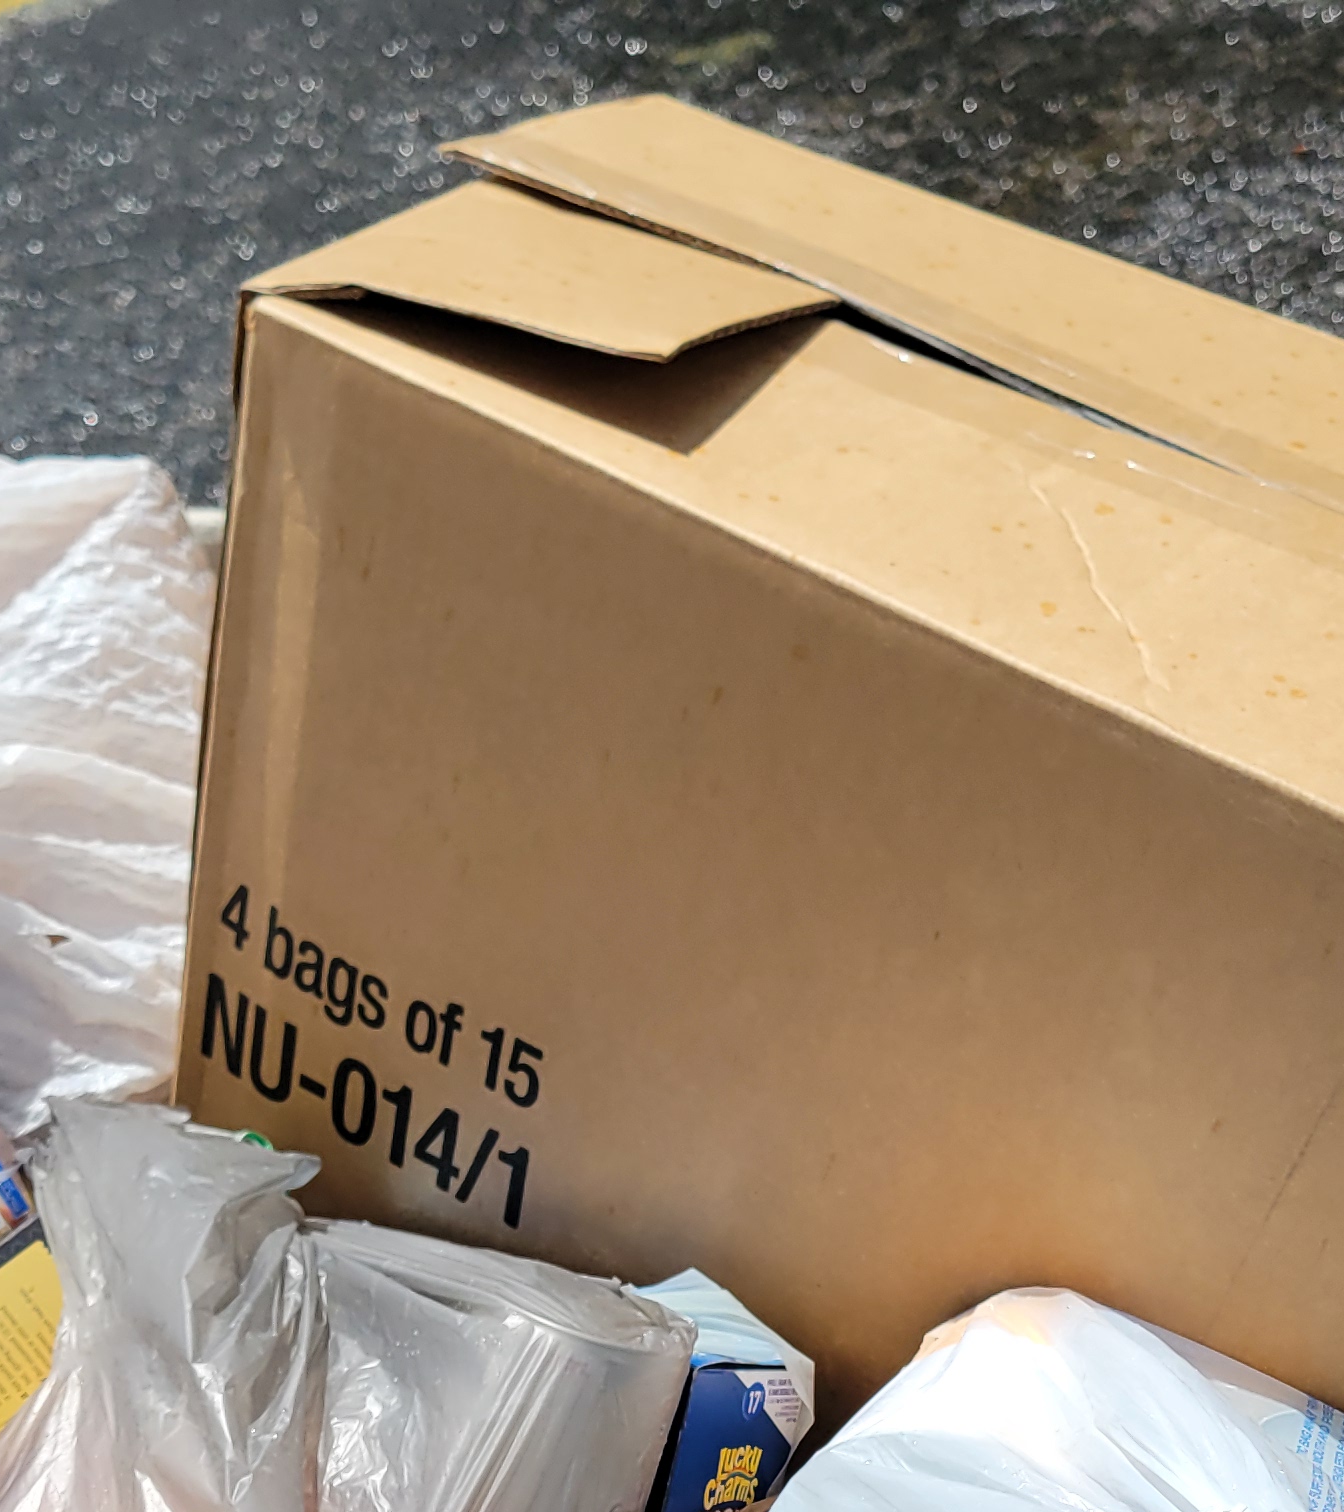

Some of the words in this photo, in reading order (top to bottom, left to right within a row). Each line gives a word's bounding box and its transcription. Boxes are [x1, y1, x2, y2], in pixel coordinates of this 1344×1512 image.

[221, 884, 250, 950] 4
[264, 905, 389, 1029] bags
[405, 1000, 465, 1066] of
[481, 1027, 544, 1108] 15
[201, 973, 530, 1229] NU-014/1
[703, 1476, 758, 1510] Charms
[717, 1444, 762, 1481] Lucky
